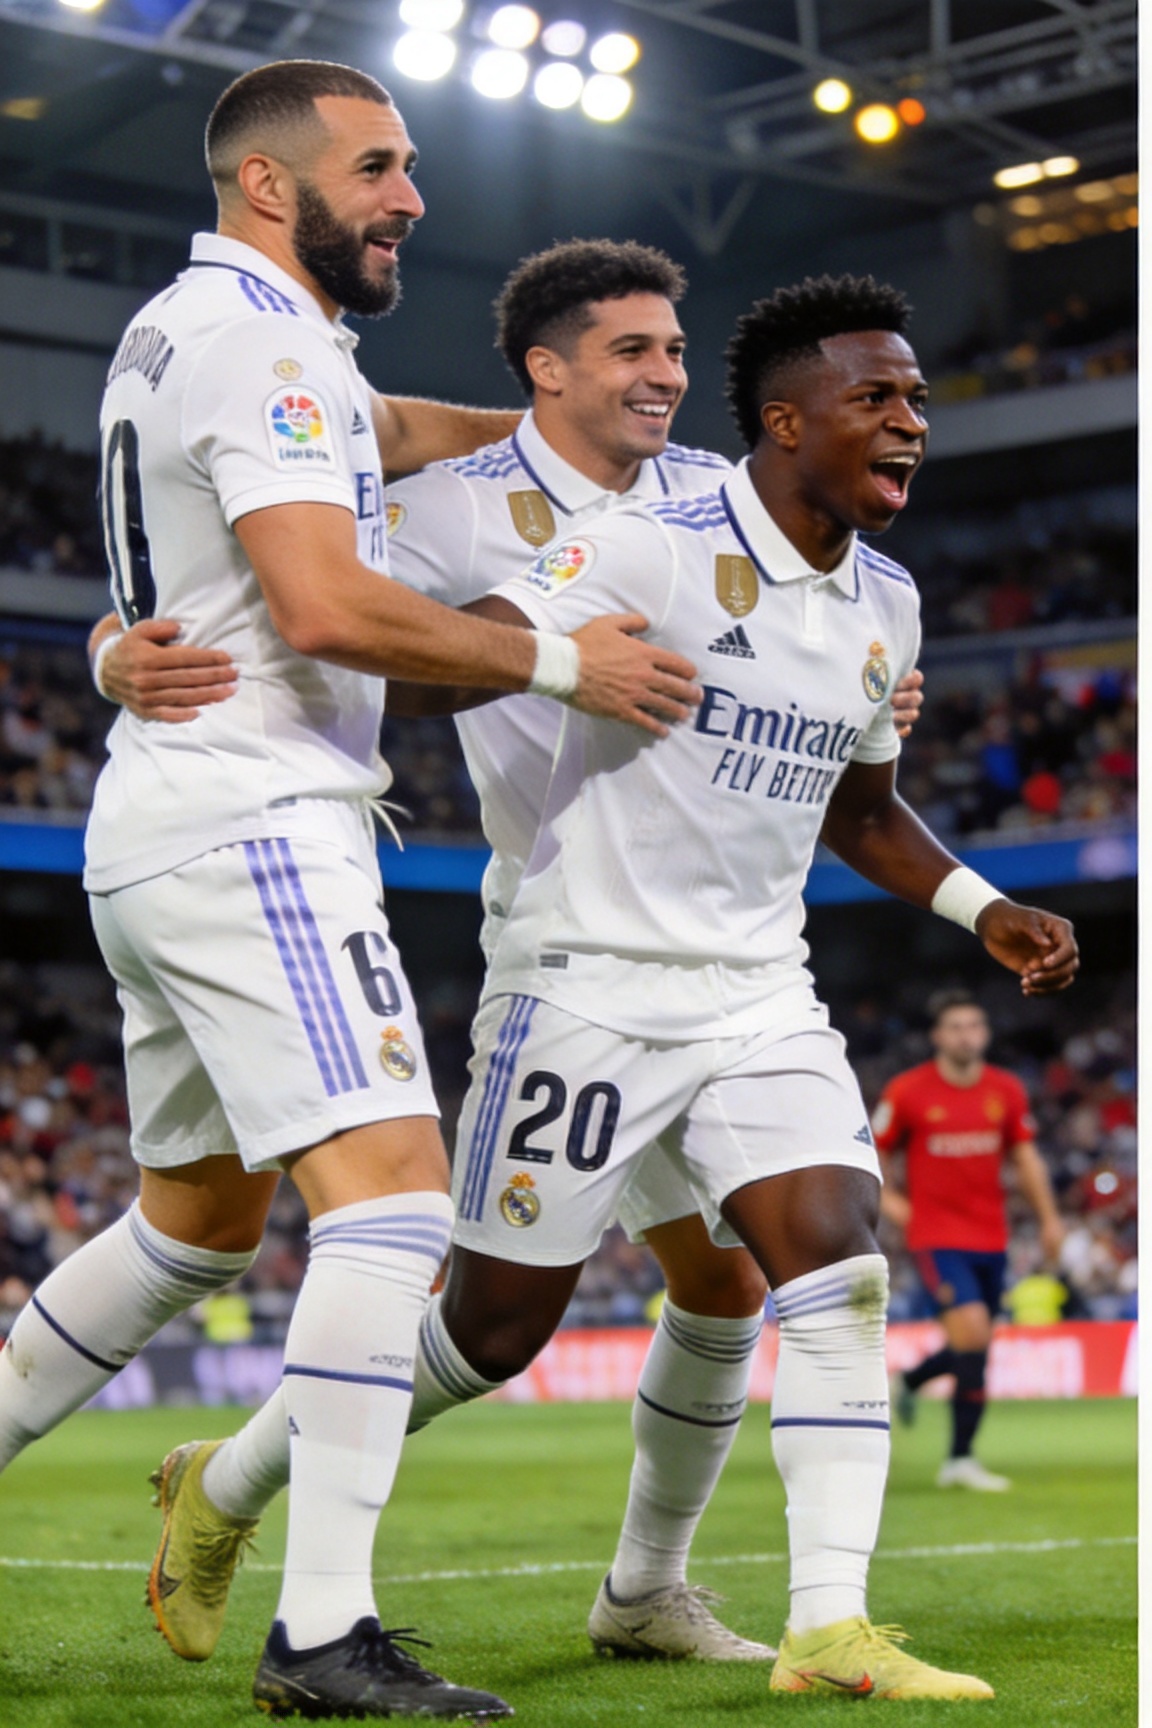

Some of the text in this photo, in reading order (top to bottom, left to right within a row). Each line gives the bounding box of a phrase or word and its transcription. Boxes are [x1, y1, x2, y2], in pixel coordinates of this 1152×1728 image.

[711, 748, 766, 793] FLY
[341, 931, 402, 1017] 6
[506, 1070, 623, 1172] 20
